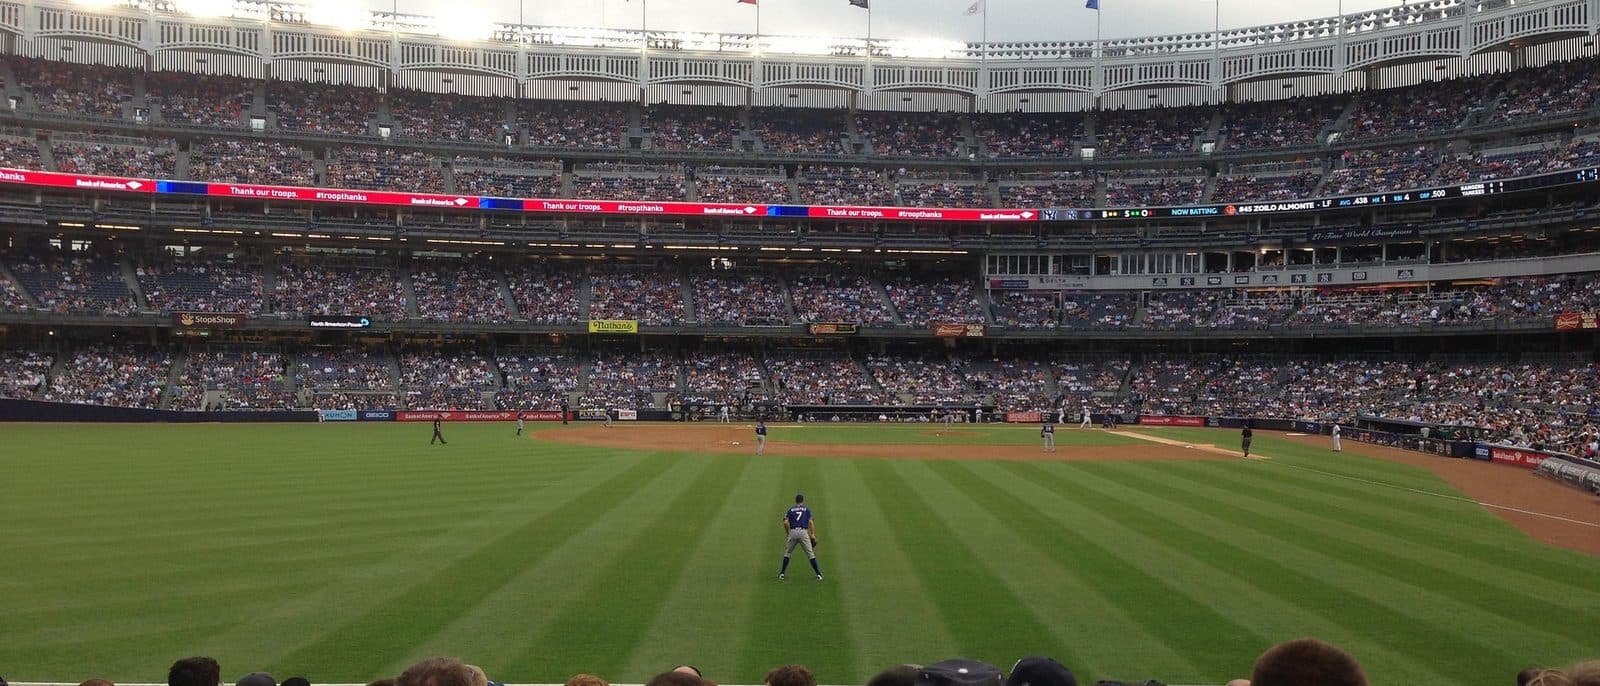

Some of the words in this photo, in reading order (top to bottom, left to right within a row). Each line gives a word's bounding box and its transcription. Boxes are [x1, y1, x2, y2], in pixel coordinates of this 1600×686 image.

[76, 179, 92, 187] Bank
[100, 180, 126, 189] America
[1460, 183, 1484, 191] RANGERS
[230, 186, 254, 195] Thank
[272, 190, 299, 198] troops.
[316, 192, 368, 200] #troopthanks
[1353, 197, 1368, 205] .438
[1431, 190, 1446, 198] .500
[1278, 202, 1314, 210] ALMONTE
[1322, 200, 1332, 208] LF
[1345, 230, 1370, 238] World
[1371, 229, 1412, 238] Champions
[194, 316, 236, 325] Stop&Shop
[593, 320, 634, 330] Nathan's
[796, 512, 802, 520] 7
